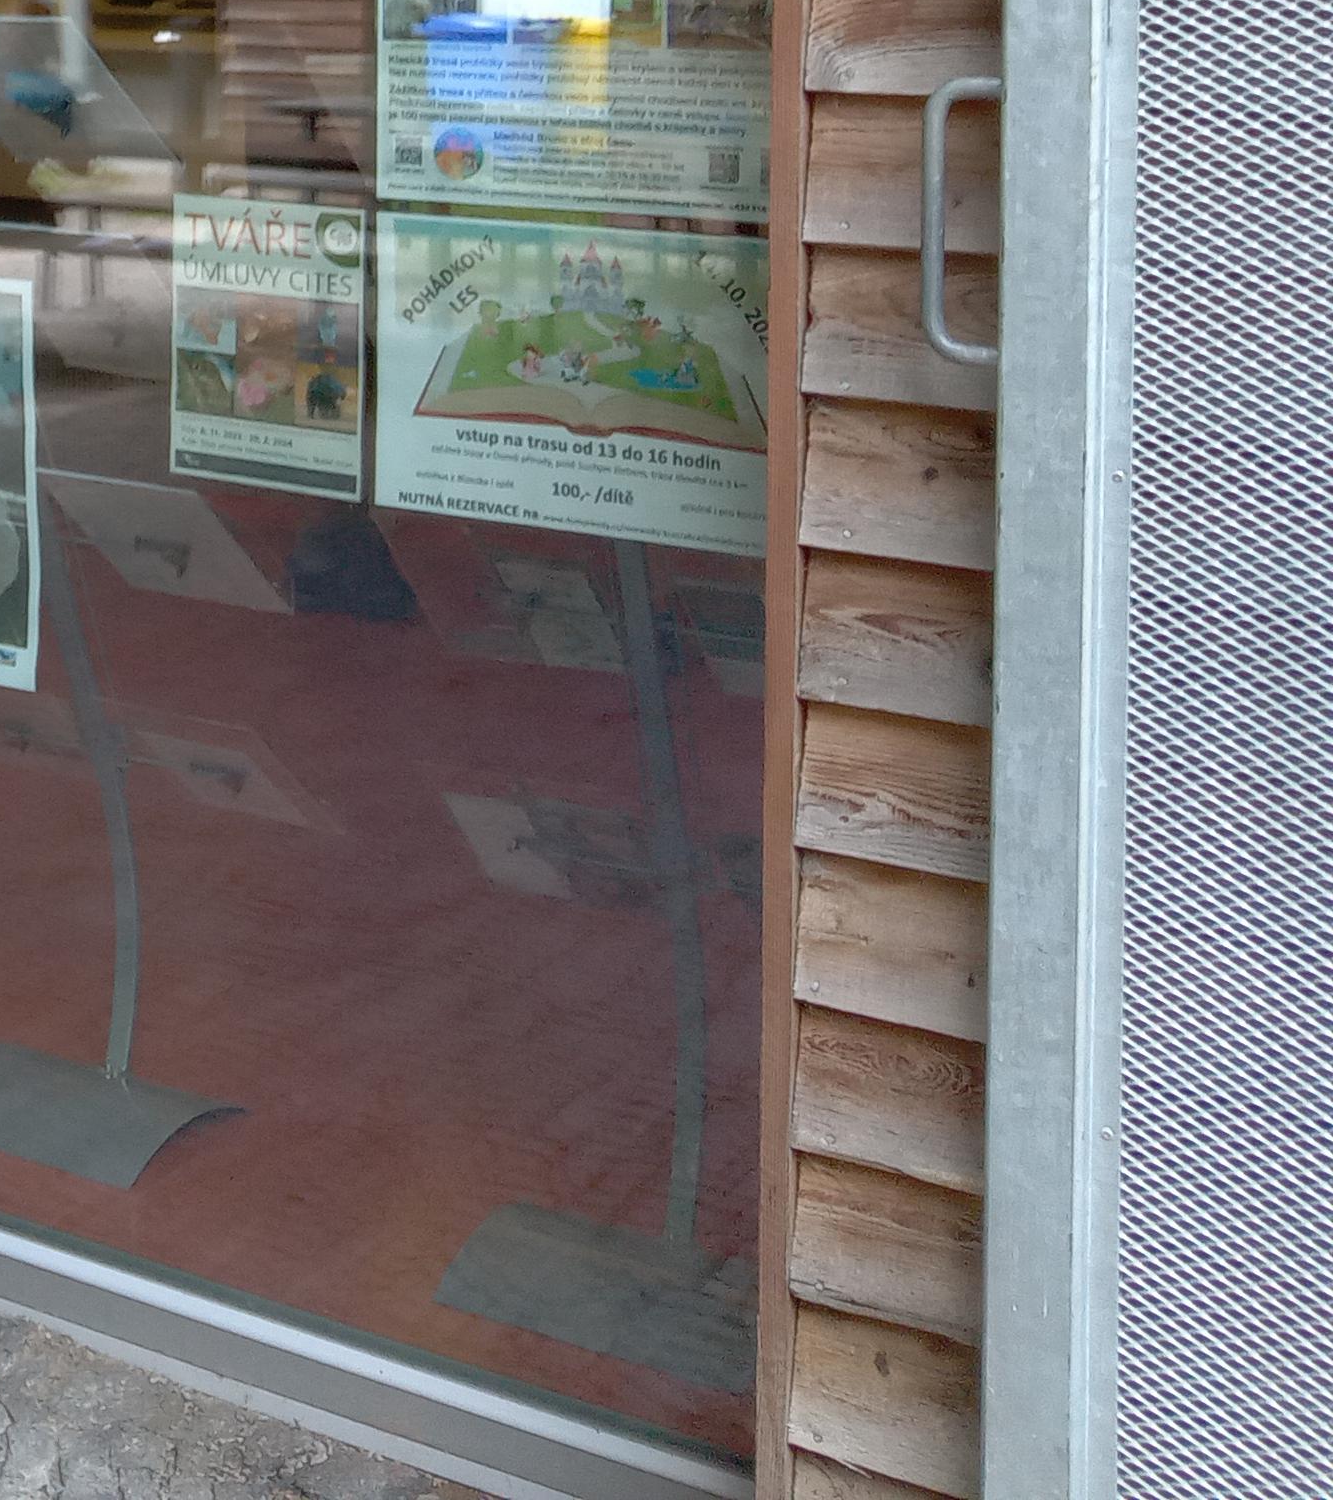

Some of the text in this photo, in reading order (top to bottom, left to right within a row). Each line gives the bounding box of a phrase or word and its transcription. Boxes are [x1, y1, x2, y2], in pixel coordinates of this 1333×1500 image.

[183, 207, 312, 260] TVÁŘE
[183, 254, 352, 298] ÚMLUVY CITES
[403, 234, 495, 325] POHÁDKOVÝ
[449, 285, 480, 314] LES
[456, 428, 721, 472] vstup na trasu od 13 do 16 hodin
[398, 490, 539, 520] NUTNÁ REZERVACE na
[551, 482, 635, 506] 100,- /dítě
